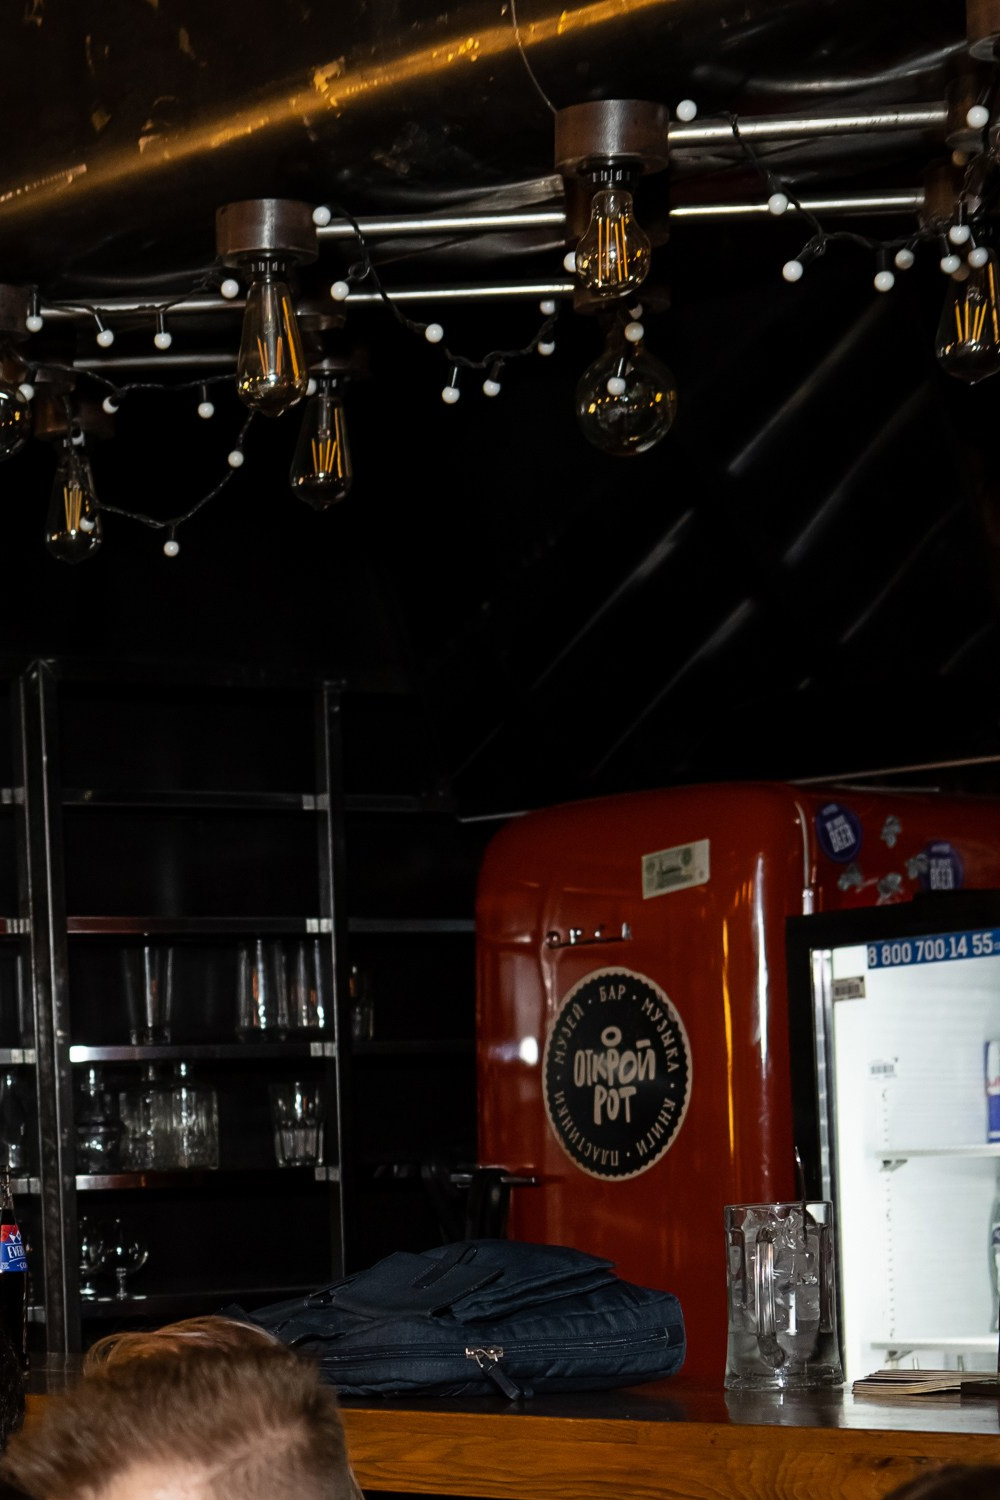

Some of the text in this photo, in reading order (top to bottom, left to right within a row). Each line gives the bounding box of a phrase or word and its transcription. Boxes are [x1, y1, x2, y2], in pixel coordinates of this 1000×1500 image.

[868, 932, 993, 966] 8 800 700 14 55
[553, 985, 680, 1167] БАР МУЗЫКА КНИГИ ПЛАСТИНКИ МУЗЕЙ
[573, 1039, 656, 1087] ОТКРОЙ
[593, 1084, 637, 1126] РОТ
